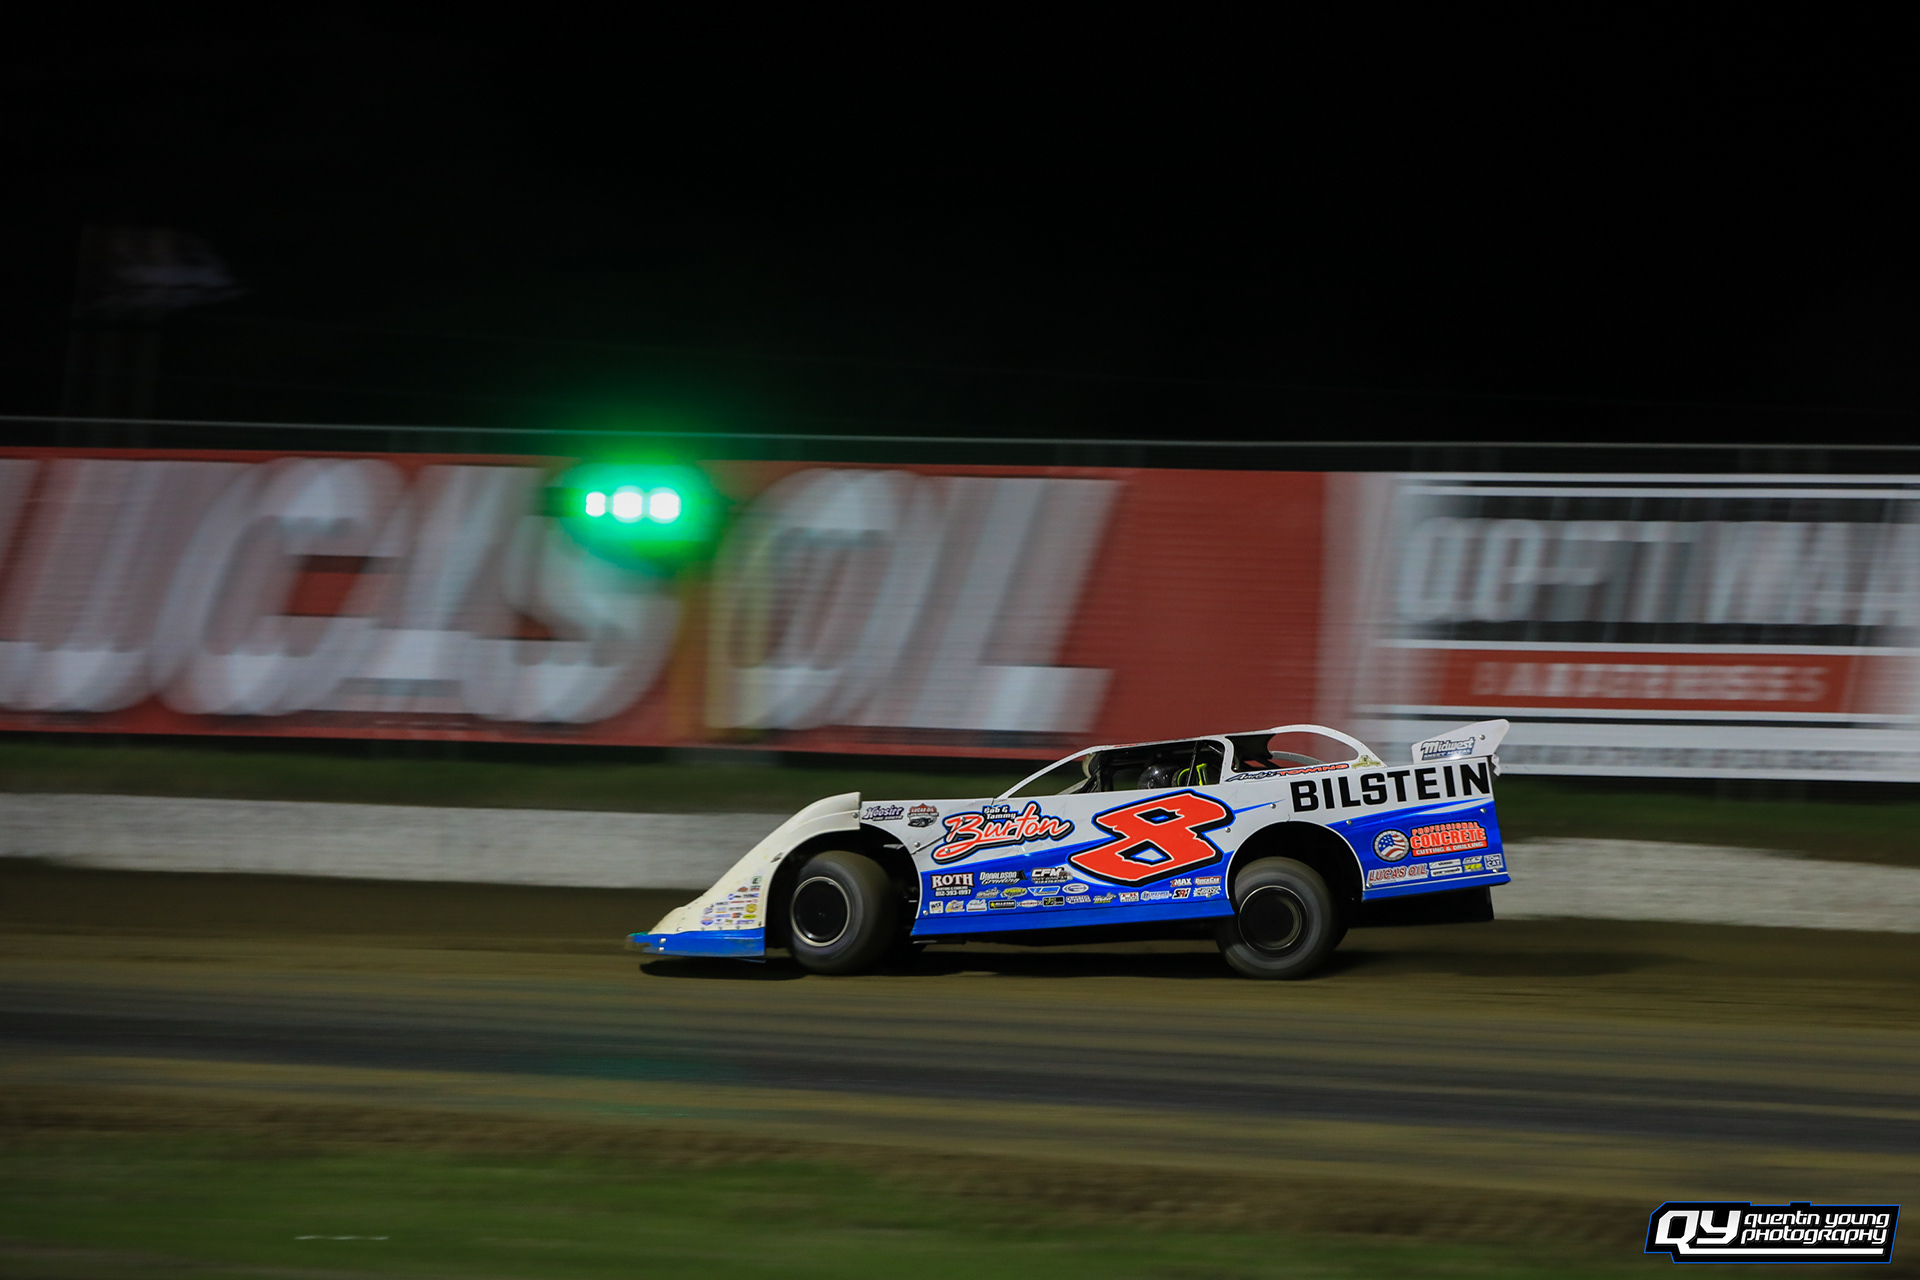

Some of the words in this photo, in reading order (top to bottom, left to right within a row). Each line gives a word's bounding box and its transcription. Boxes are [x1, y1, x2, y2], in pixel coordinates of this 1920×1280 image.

[702, 466, 1128, 734] OIL
[1420, 736, 1475, 755] Midwest
[1276, 763, 1349, 776] TOWING
[1290, 762, 1490, 812] BILSTEIN
[932, 802, 1073, 862] Burton
[1411, 821, 1480, 836] PROFESSIONAL
[1067, 790, 1234, 887] 8
[1410, 828, 1486, 849] CONCRETE
[1416, 847, 1445, 856] CUTTING
[1453, 841, 1484, 850] DRILLING
[931, 873, 974, 889] ROTH
[980, 872, 1017, 880] DONALDSON
[1032, 868, 1062, 877] CFM
[1369, 867, 1406, 882] LUCAS
[1408, 864, 1428, 876] OIL
